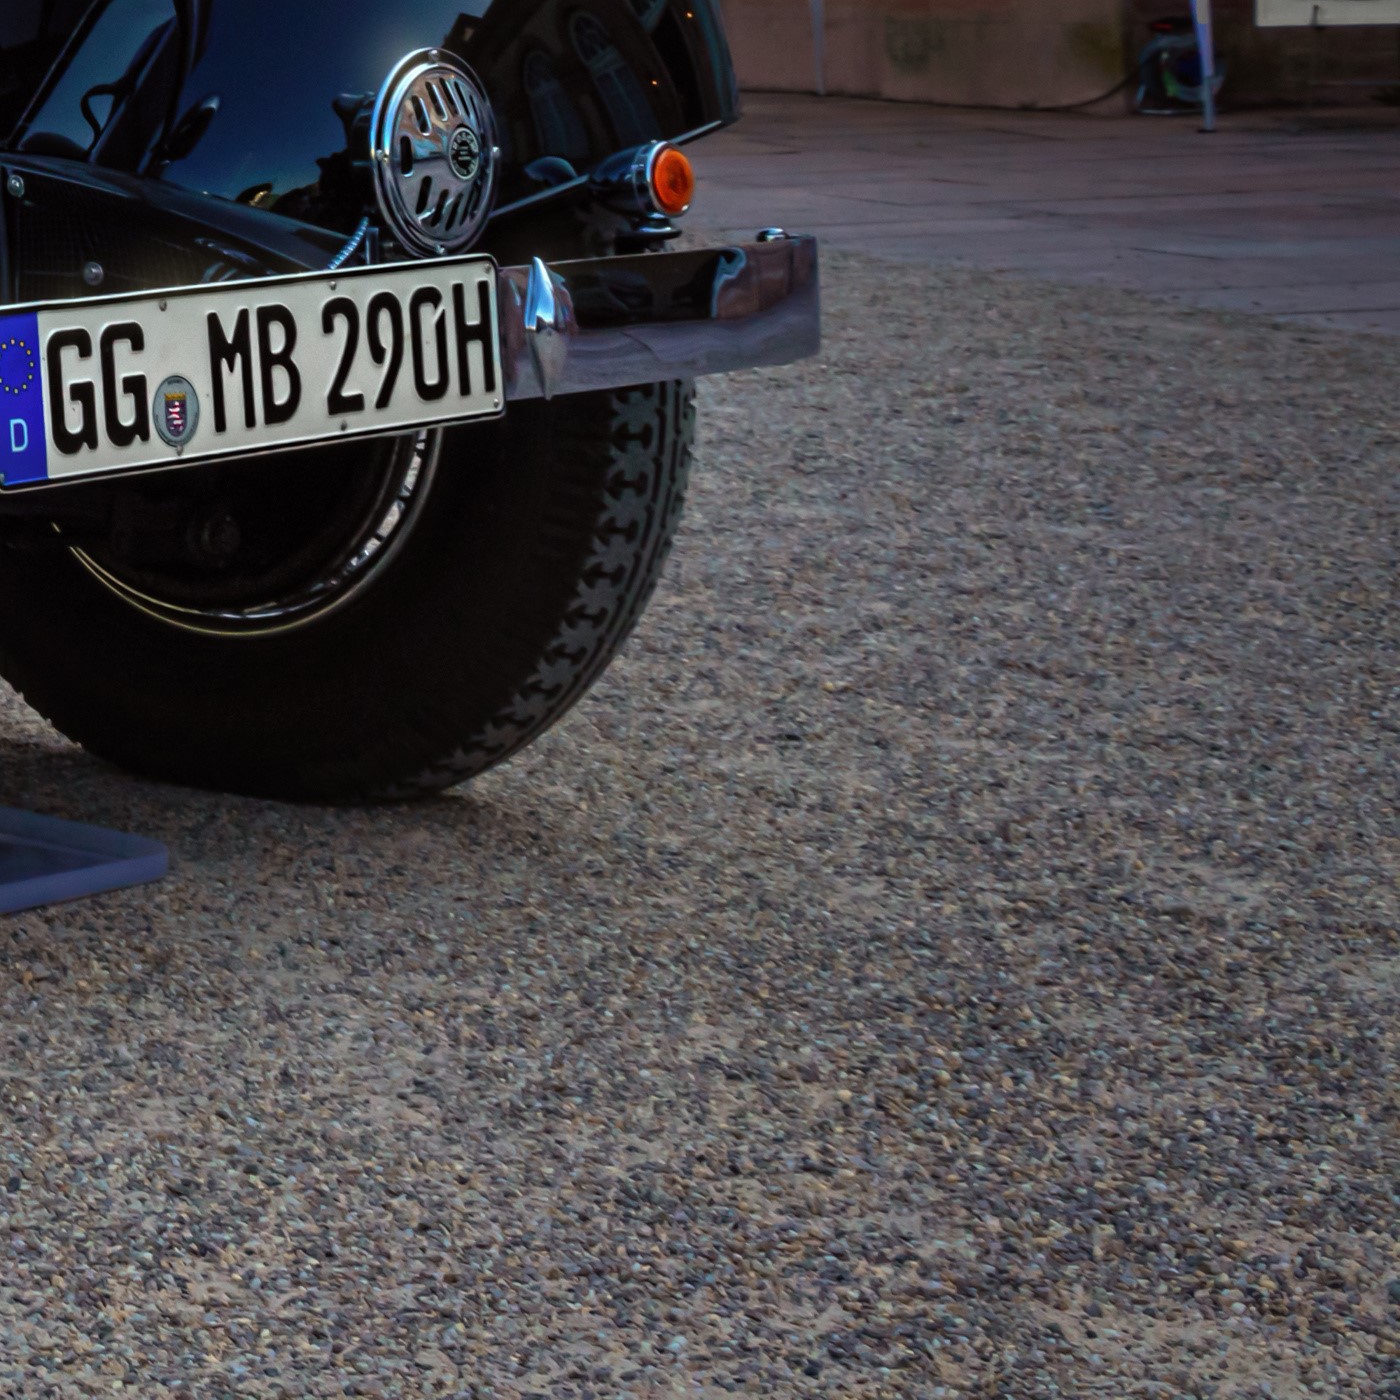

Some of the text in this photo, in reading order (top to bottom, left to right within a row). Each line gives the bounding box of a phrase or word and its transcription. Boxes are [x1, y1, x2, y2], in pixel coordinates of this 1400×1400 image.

[46, 280, 496, 454] GG MB 290H
[9, 418, 29, 453] D
